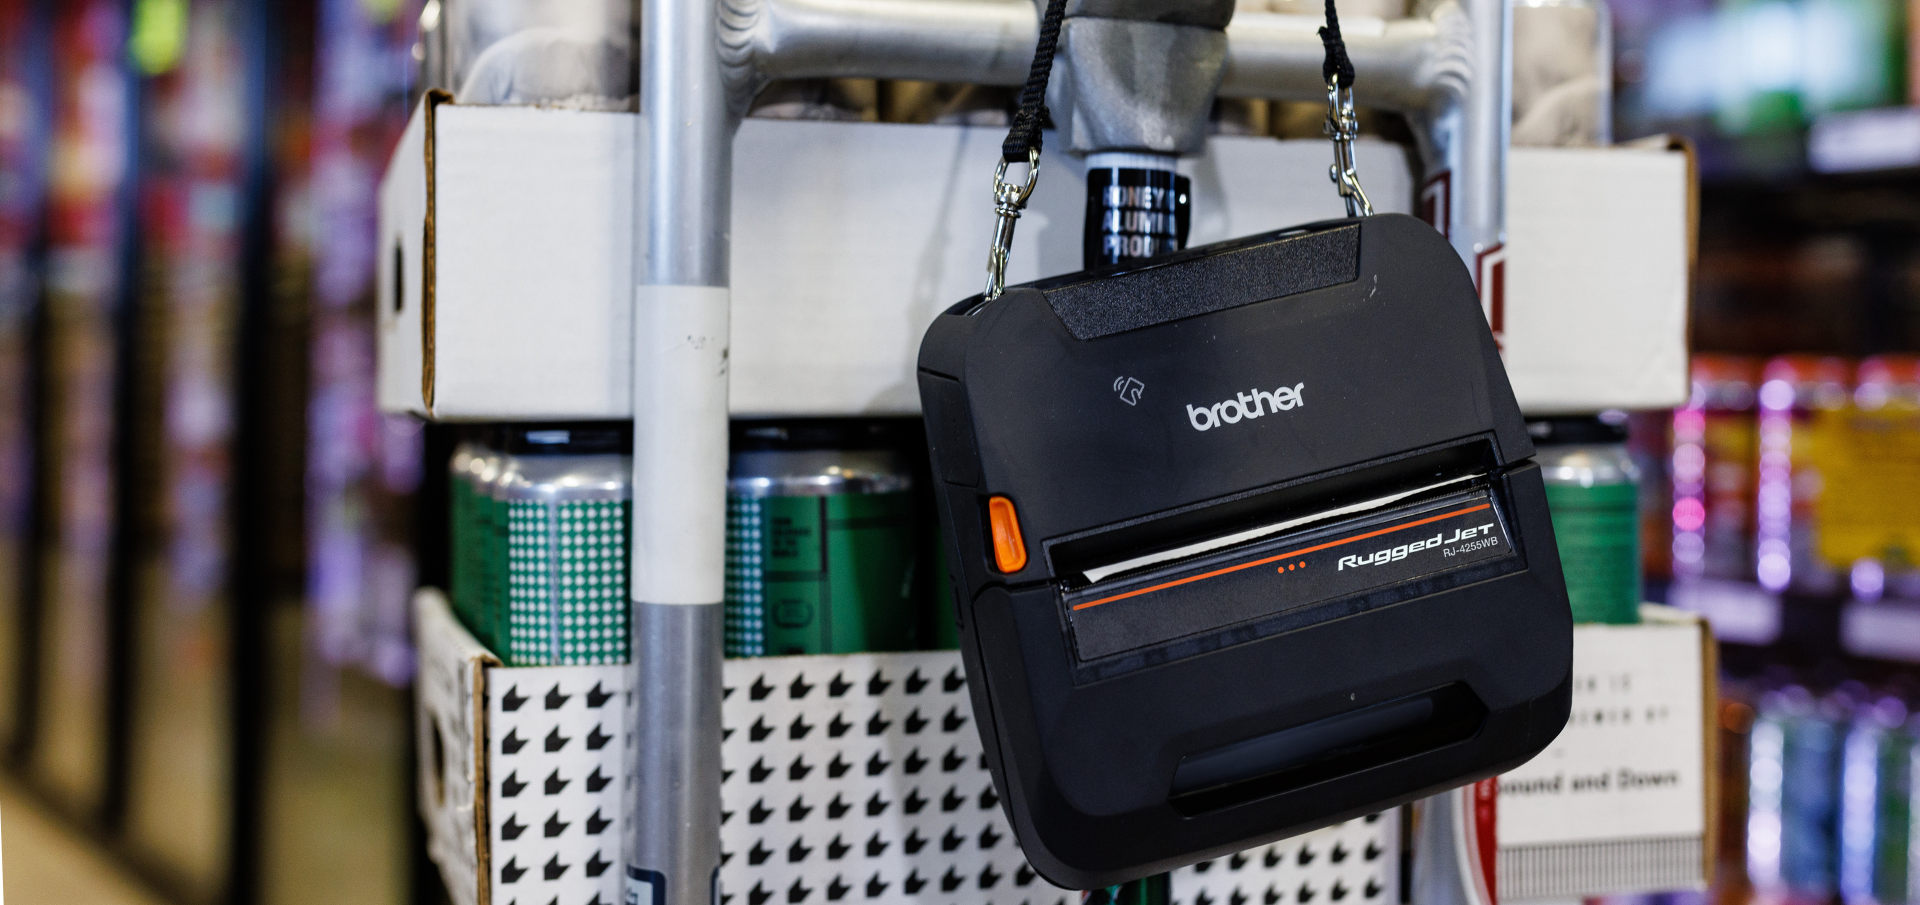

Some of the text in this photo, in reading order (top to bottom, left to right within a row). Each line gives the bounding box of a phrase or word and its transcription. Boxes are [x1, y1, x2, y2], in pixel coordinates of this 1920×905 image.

[1187, 382, 1304, 431] brother
[1443, 536, 1498, 558] RJ-4255WB
[1498, 771, 1562, 796] ound
[1571, 770, 1610, 794] and
[1617, 766, 1679, 791] Down
